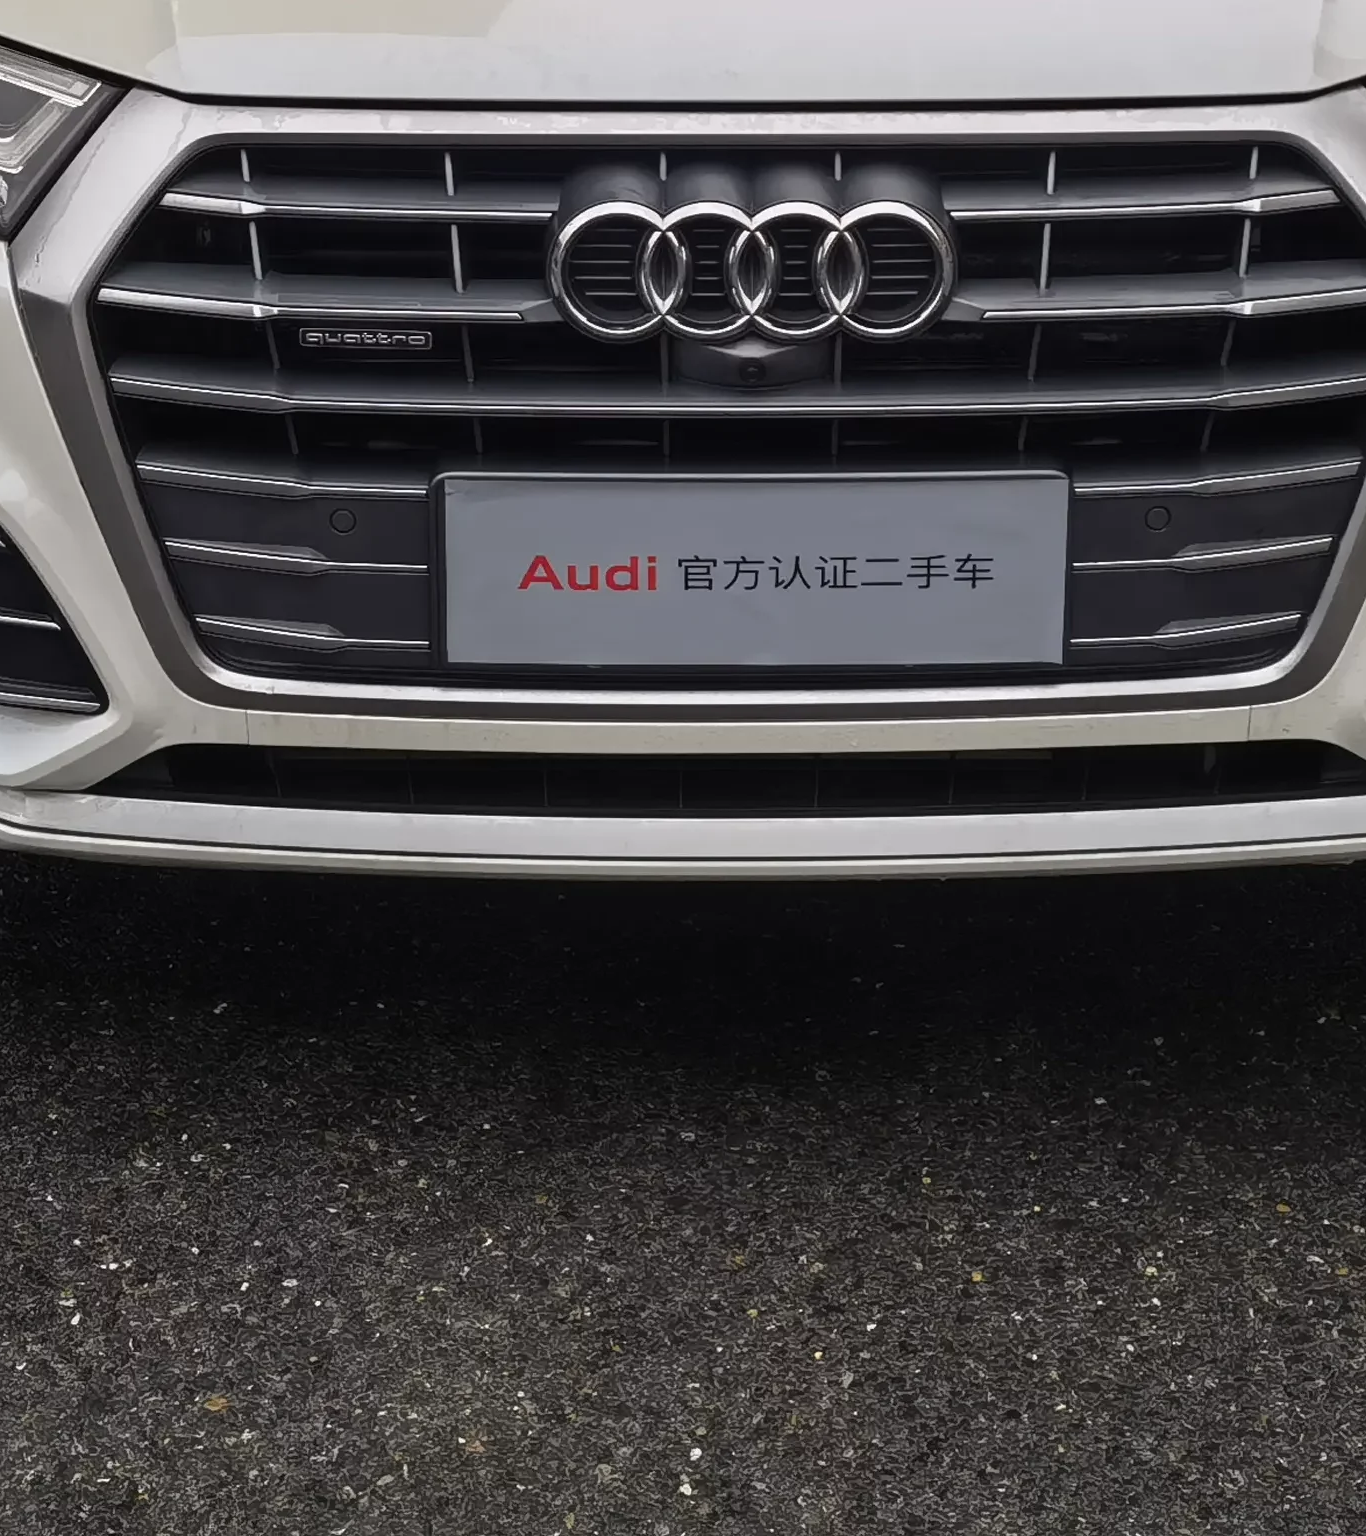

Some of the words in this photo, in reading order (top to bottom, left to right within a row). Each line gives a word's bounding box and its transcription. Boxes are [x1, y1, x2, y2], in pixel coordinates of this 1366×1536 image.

[305, 332, 425, 345] quattro
[517, 555, 658, 592] Audi
[677, 553, 995, 591] 官方认证二手车
